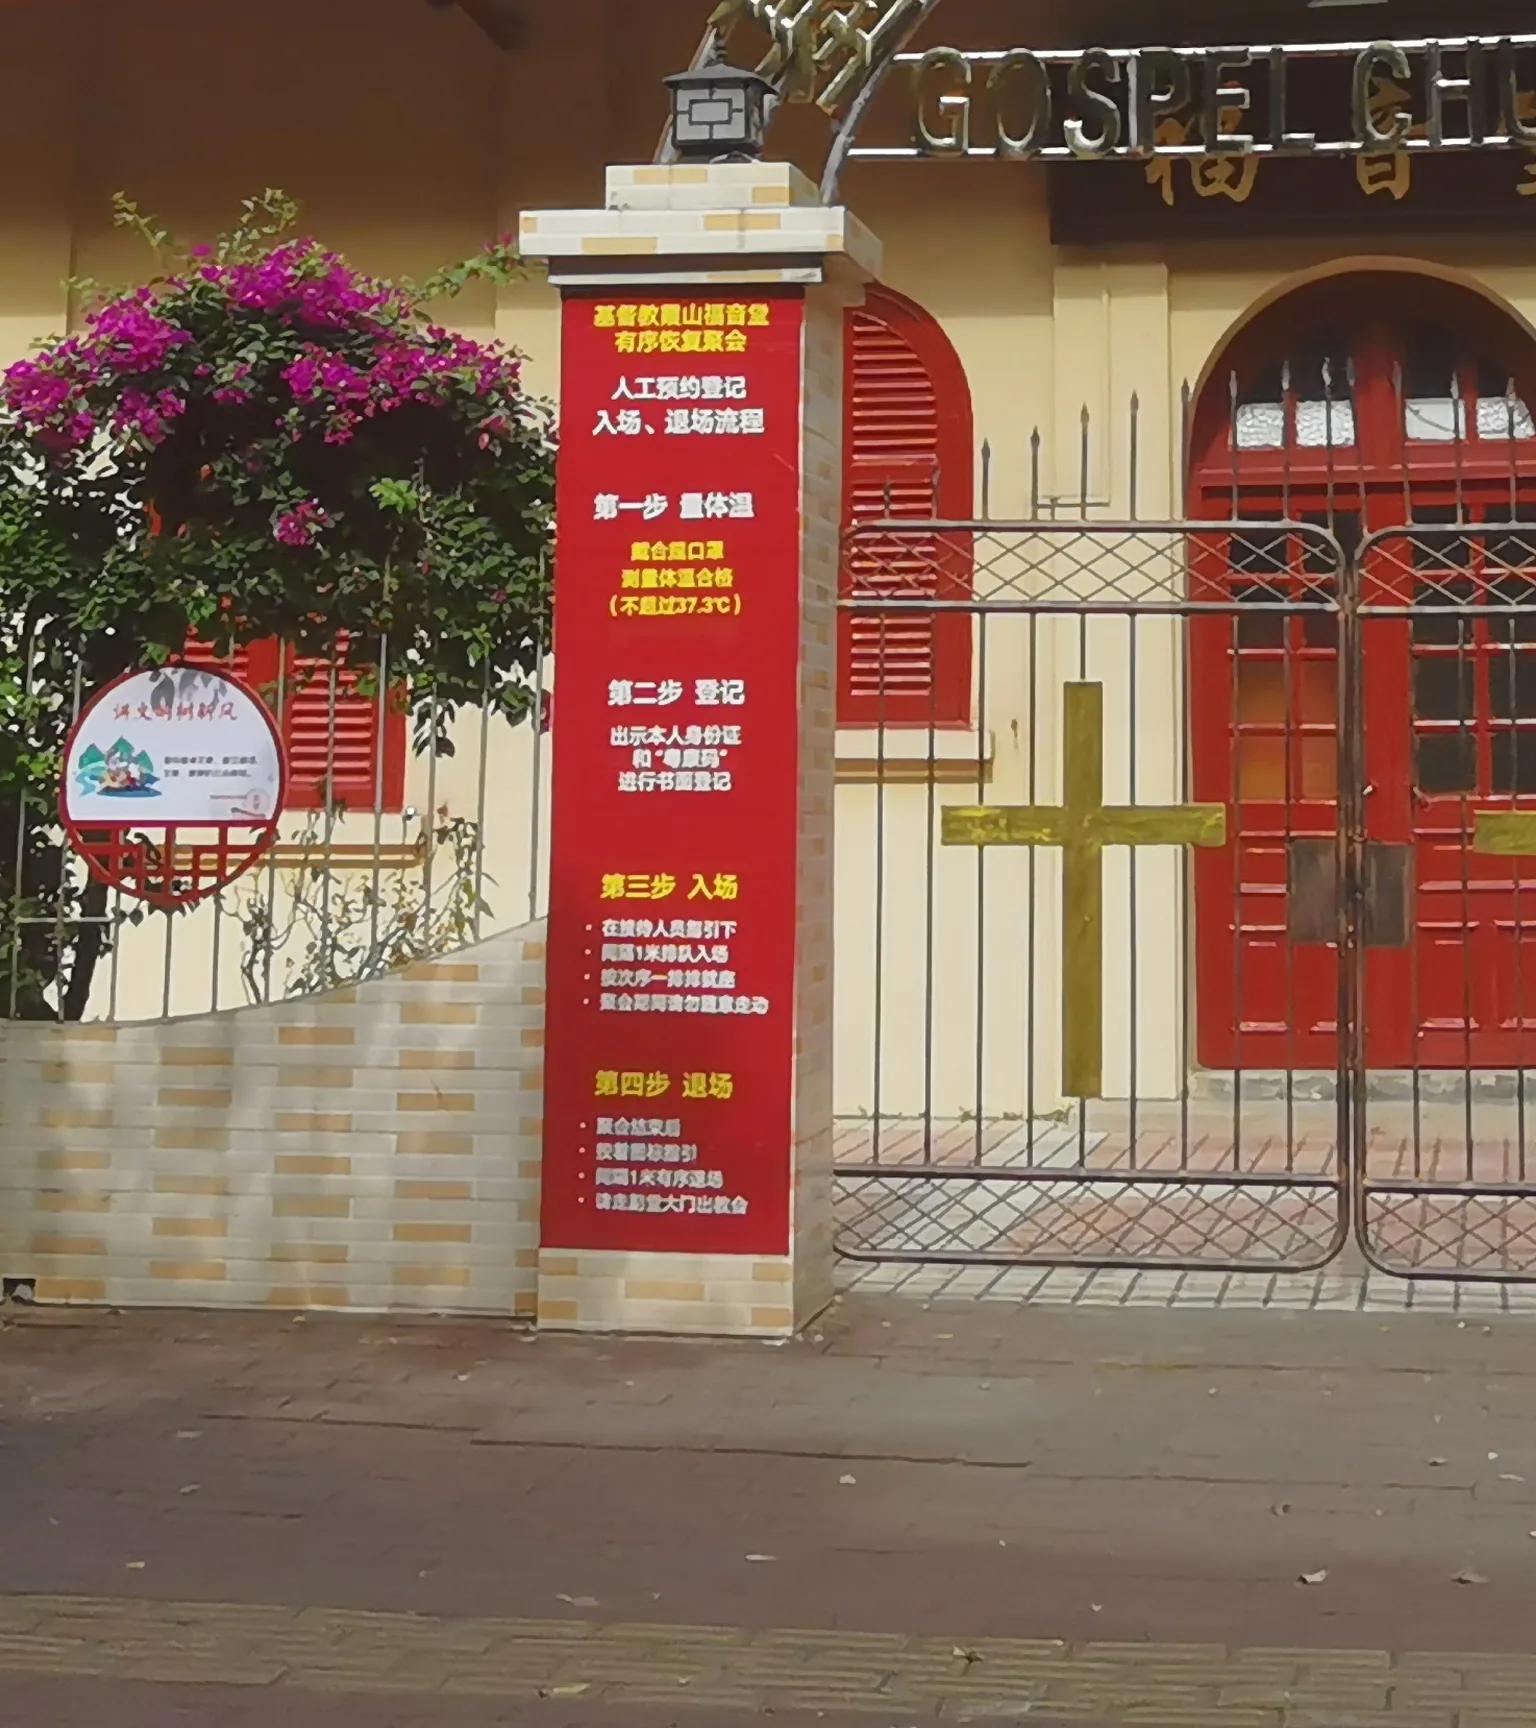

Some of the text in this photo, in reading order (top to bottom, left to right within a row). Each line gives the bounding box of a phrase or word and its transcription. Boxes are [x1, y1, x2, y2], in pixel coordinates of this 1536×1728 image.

[910, 44, 1316, 158] GOSPEL
[610, 375, 747, 401] 人工预约登记
[591, 407, 765, 436] 入场、退场流程
[593, 491, 755, 521] 第一步 量体温
[607, 678, 746, 706] 第二步 登记
[610, 724, 742, 747] 出示本人身份证
[599, 872, 739, 900] 第三步 入场
[594, 1070, 734, 1099] 第四步 退场
